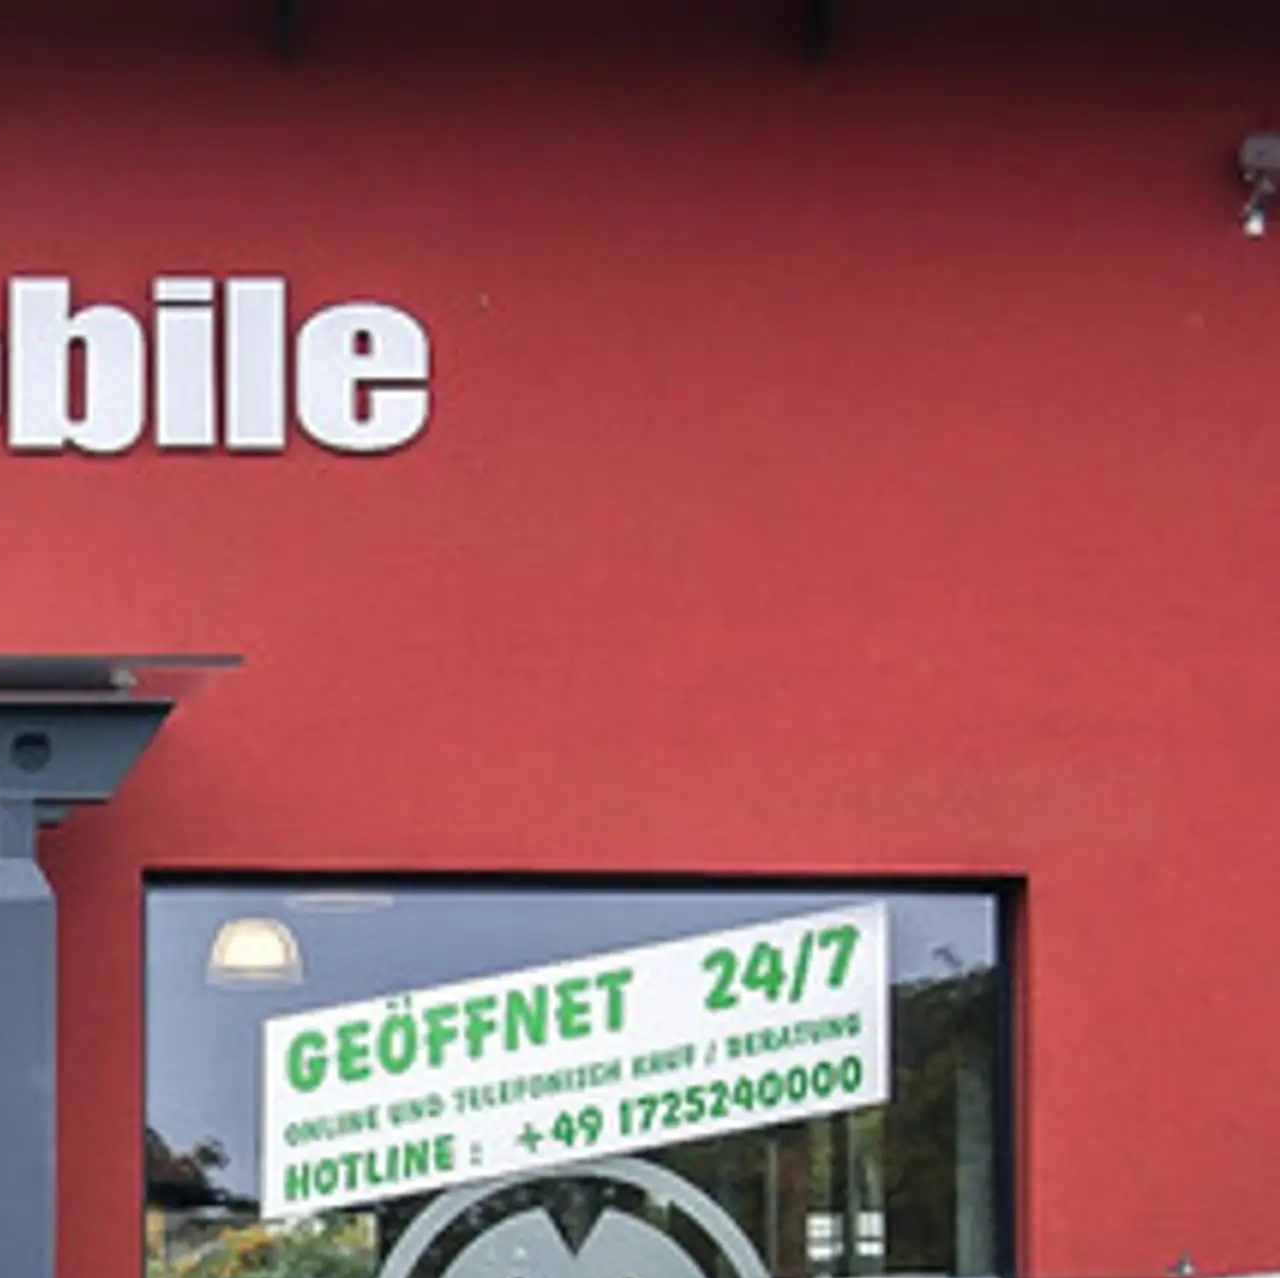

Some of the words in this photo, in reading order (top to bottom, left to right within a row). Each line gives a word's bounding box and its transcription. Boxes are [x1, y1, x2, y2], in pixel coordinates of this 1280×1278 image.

[283, 1104, 380, 1148] ONLINE
[387, 1091, 445, 1127] UND
[450, 1057, 622, 1114] TELEFONISCH
[723, 1010, 862, 1060] BERATUNG
[285, 967, 634, 1093] GEÖFFNET
[701, 924, 861, 1011] 24/7
[284, 1132, 455, 1201] HOTLINE
[517, 1103, 604, 1153] +49
[619, 1055, 863, 1136] 1725240000
